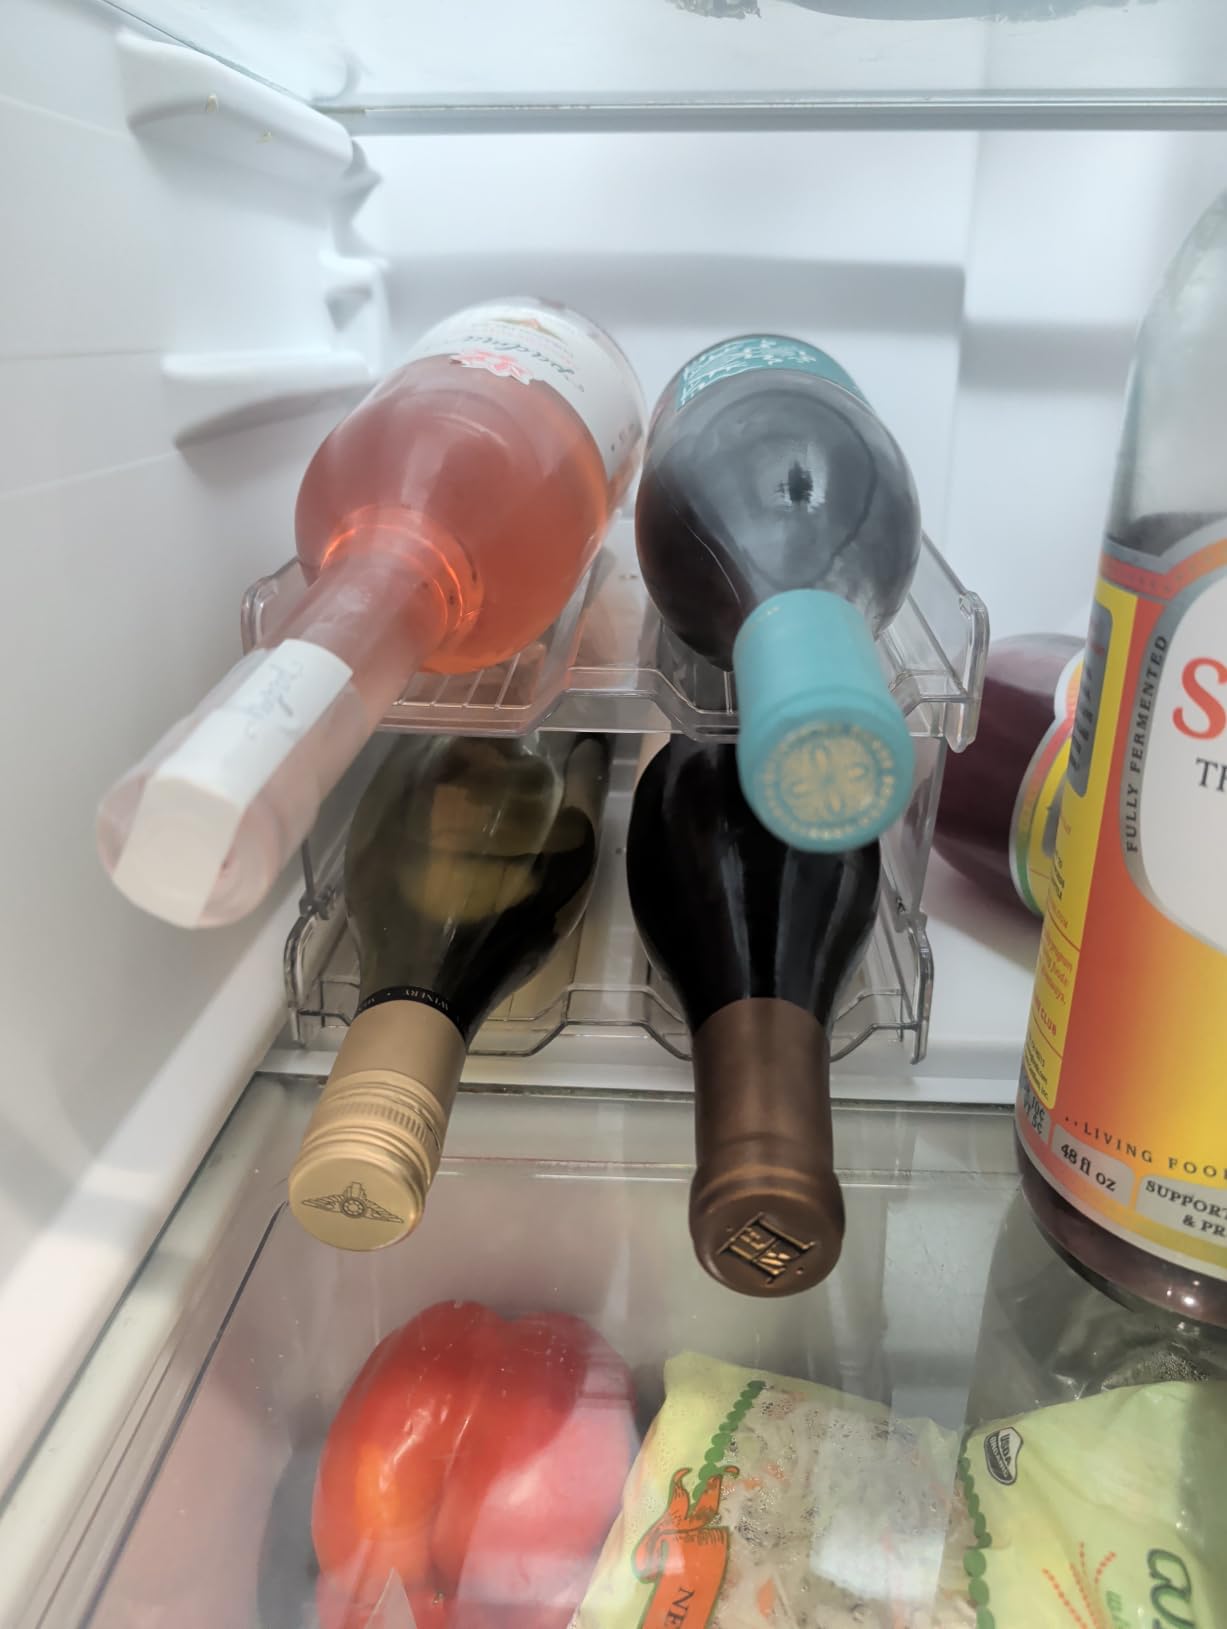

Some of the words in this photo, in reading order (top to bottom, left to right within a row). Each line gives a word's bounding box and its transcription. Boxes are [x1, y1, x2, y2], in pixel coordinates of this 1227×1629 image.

[1129, 635, 1167, 774] FERMENTED
[1126, 784, 1139, 852] FULLY
[1084, 1123, 1153, 1163] LIVING
[1061, 1143, 1077, 1165] 48
[1080, 1156, 1091, 1176] fl
[1095, 1172, 1117, 1192] oz
[1182, 1214, 1195, 1228] &
[1001, 1433, 1012, 1467] USDA
